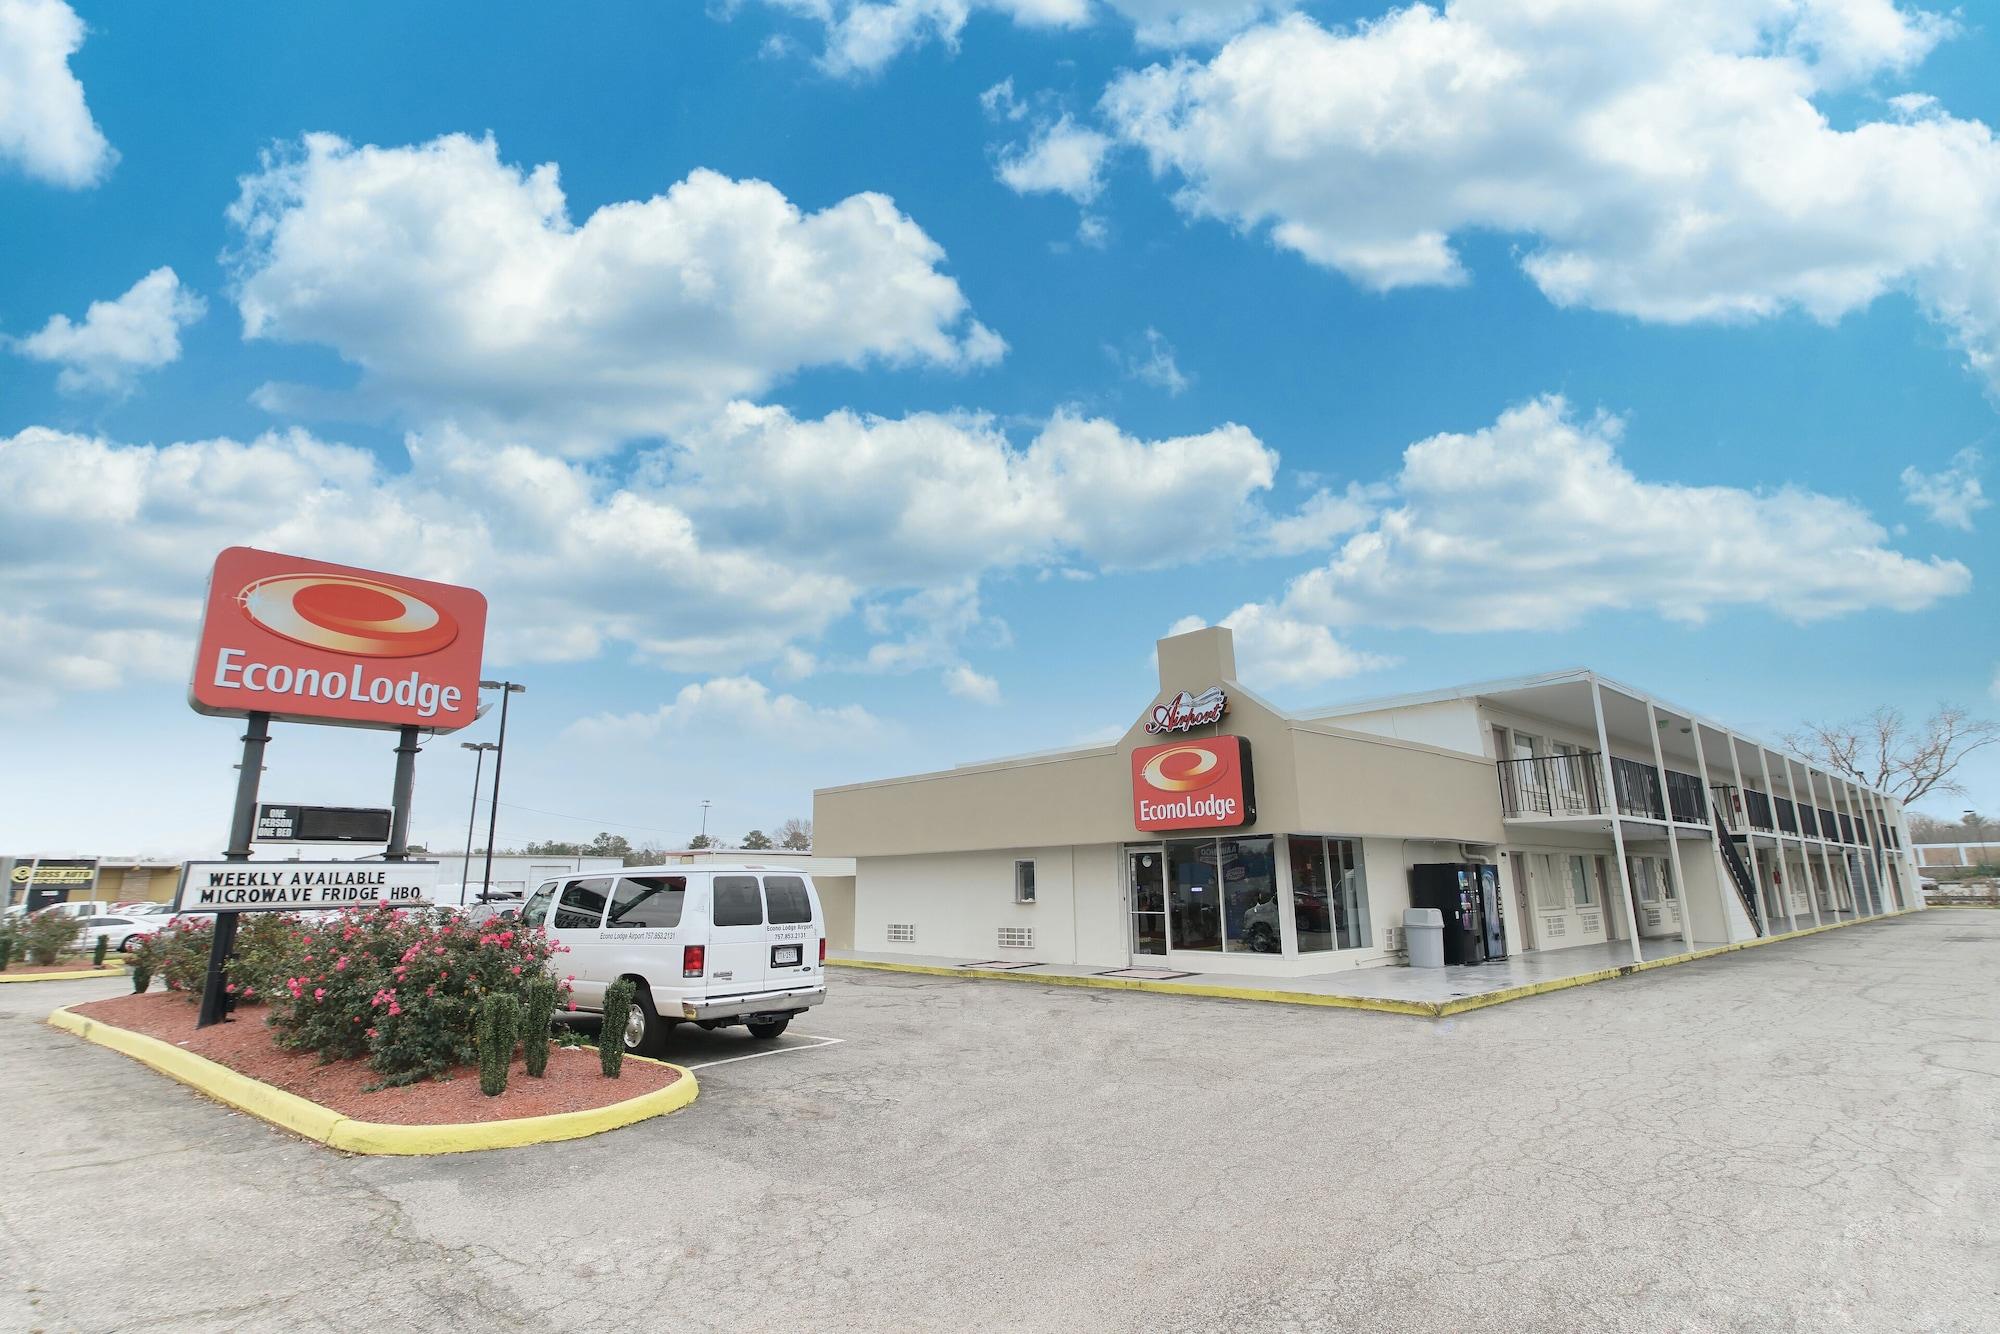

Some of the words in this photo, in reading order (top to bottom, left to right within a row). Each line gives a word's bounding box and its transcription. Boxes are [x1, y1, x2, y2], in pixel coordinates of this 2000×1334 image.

[213, 647, 462, 717] EconoLodge
[1145, 690, 1223, 734] Airport
[269, 808, 287, 818] ONE
[1140, 794, 1236, 822] EconoLodge
[260, 818, 293, 828] PERSON
[258, 828, 275, 837] ONE
[276, 828, 293, 837] BED
[209, 872, 283, 887] WEEKLY
[290, 871, 386, 885] AVAILABLE
[200, 888, 312, 904] MICROWAVE
[321, 887, 379, 901] FRIDGE
[390, 886, 420, 899] HBO
[600, 932, 613, 940] Econo
[614, 932, 628, 940] Lodge
[628, 932, 645, 941] Airport
